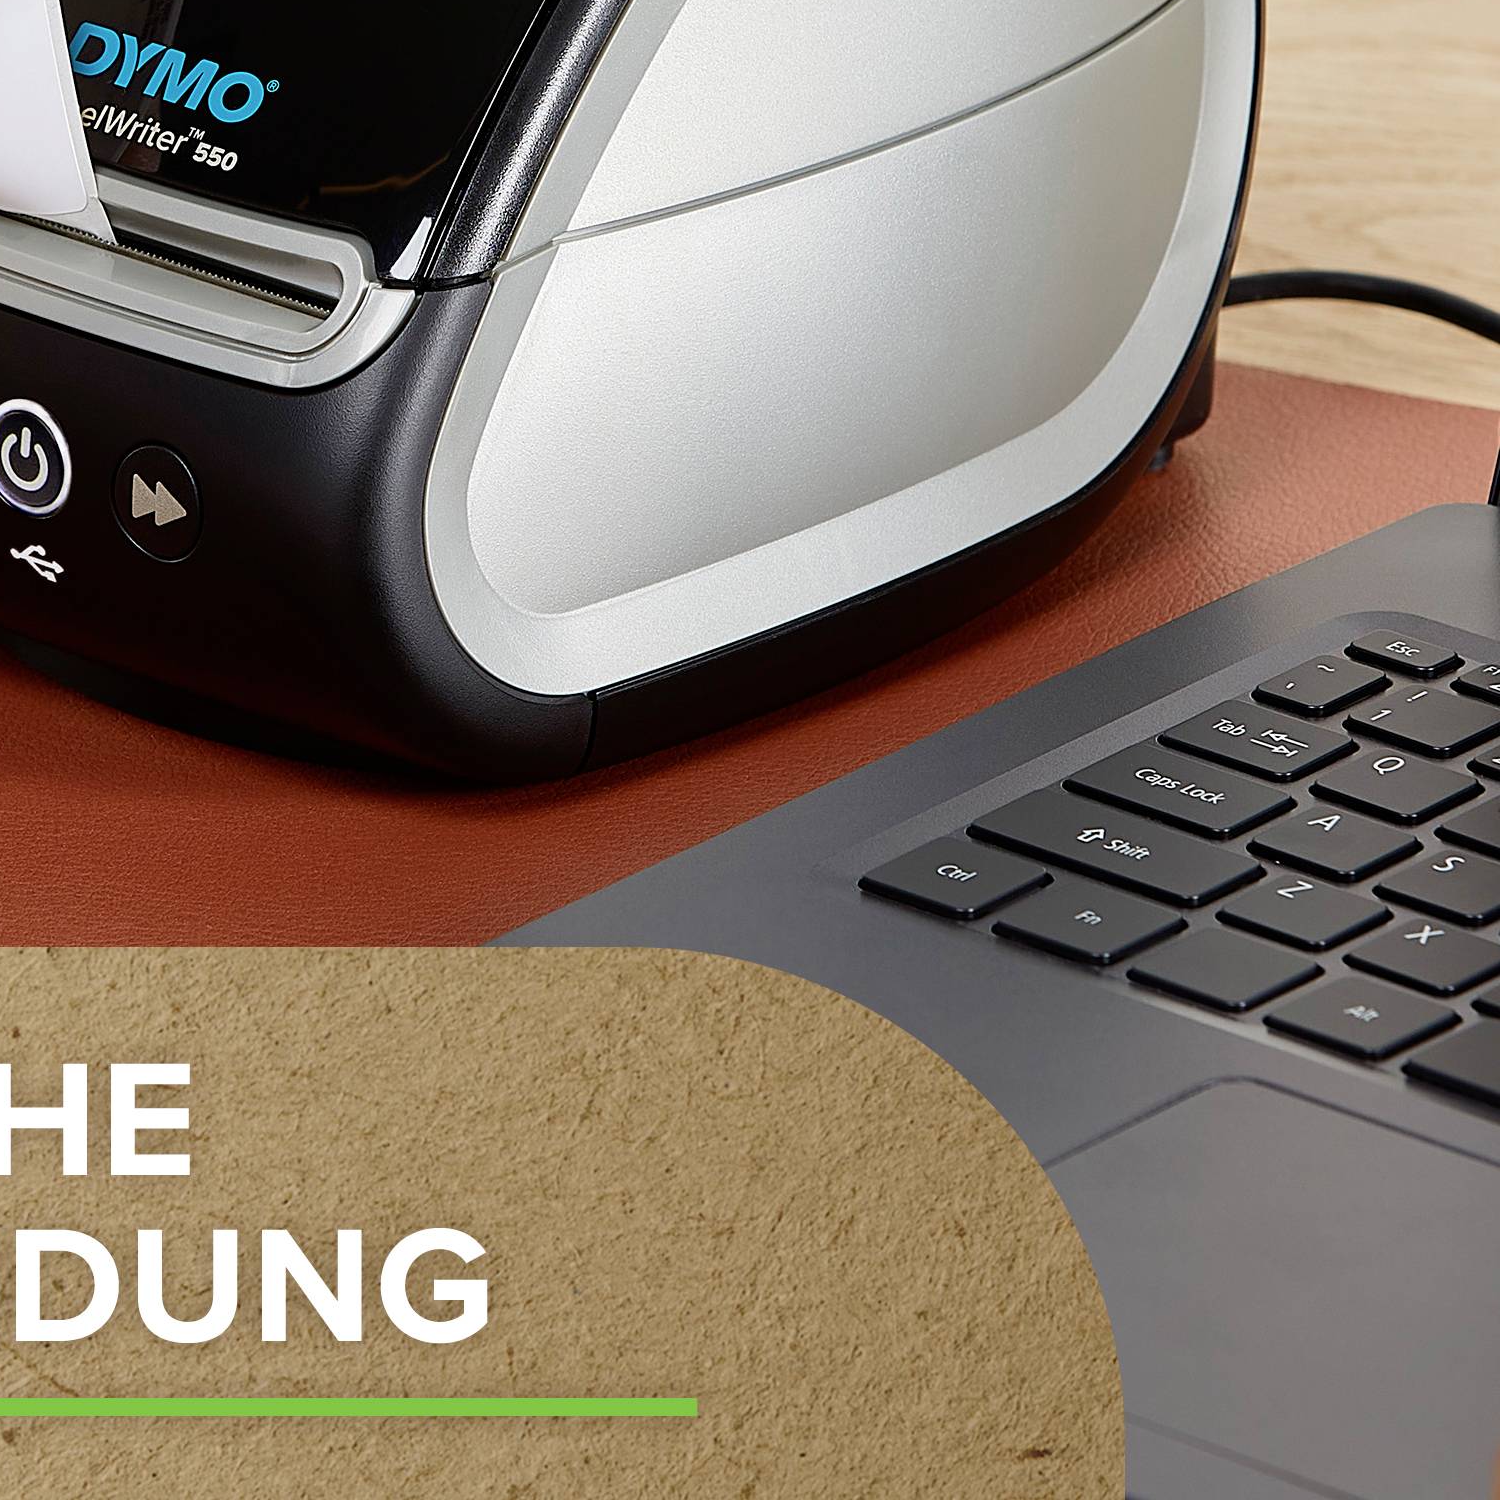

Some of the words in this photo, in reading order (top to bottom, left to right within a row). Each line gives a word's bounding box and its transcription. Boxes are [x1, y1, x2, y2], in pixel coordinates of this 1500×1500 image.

[192, 142, 238, 171] 550
[1385, 641, 1420, 657] Esc
[1370, 709, 1392, 721] 1
[1212, 718, 1246, 737] Tab
[1372, 756, 1405, 775] Q
[1135, 768, 1177, 791] Caps
[1180, 784, 1226, 805] Lock
[1307, 814, 1341, 831] A
[1103, 838, 1150, 861] Shift
[937, 864, 977, 883] Ctrl
[1431, 856, 1465, 873] S
[1276, 880, 1314, 899] Z
[1403, 924, 1445, 945] X
